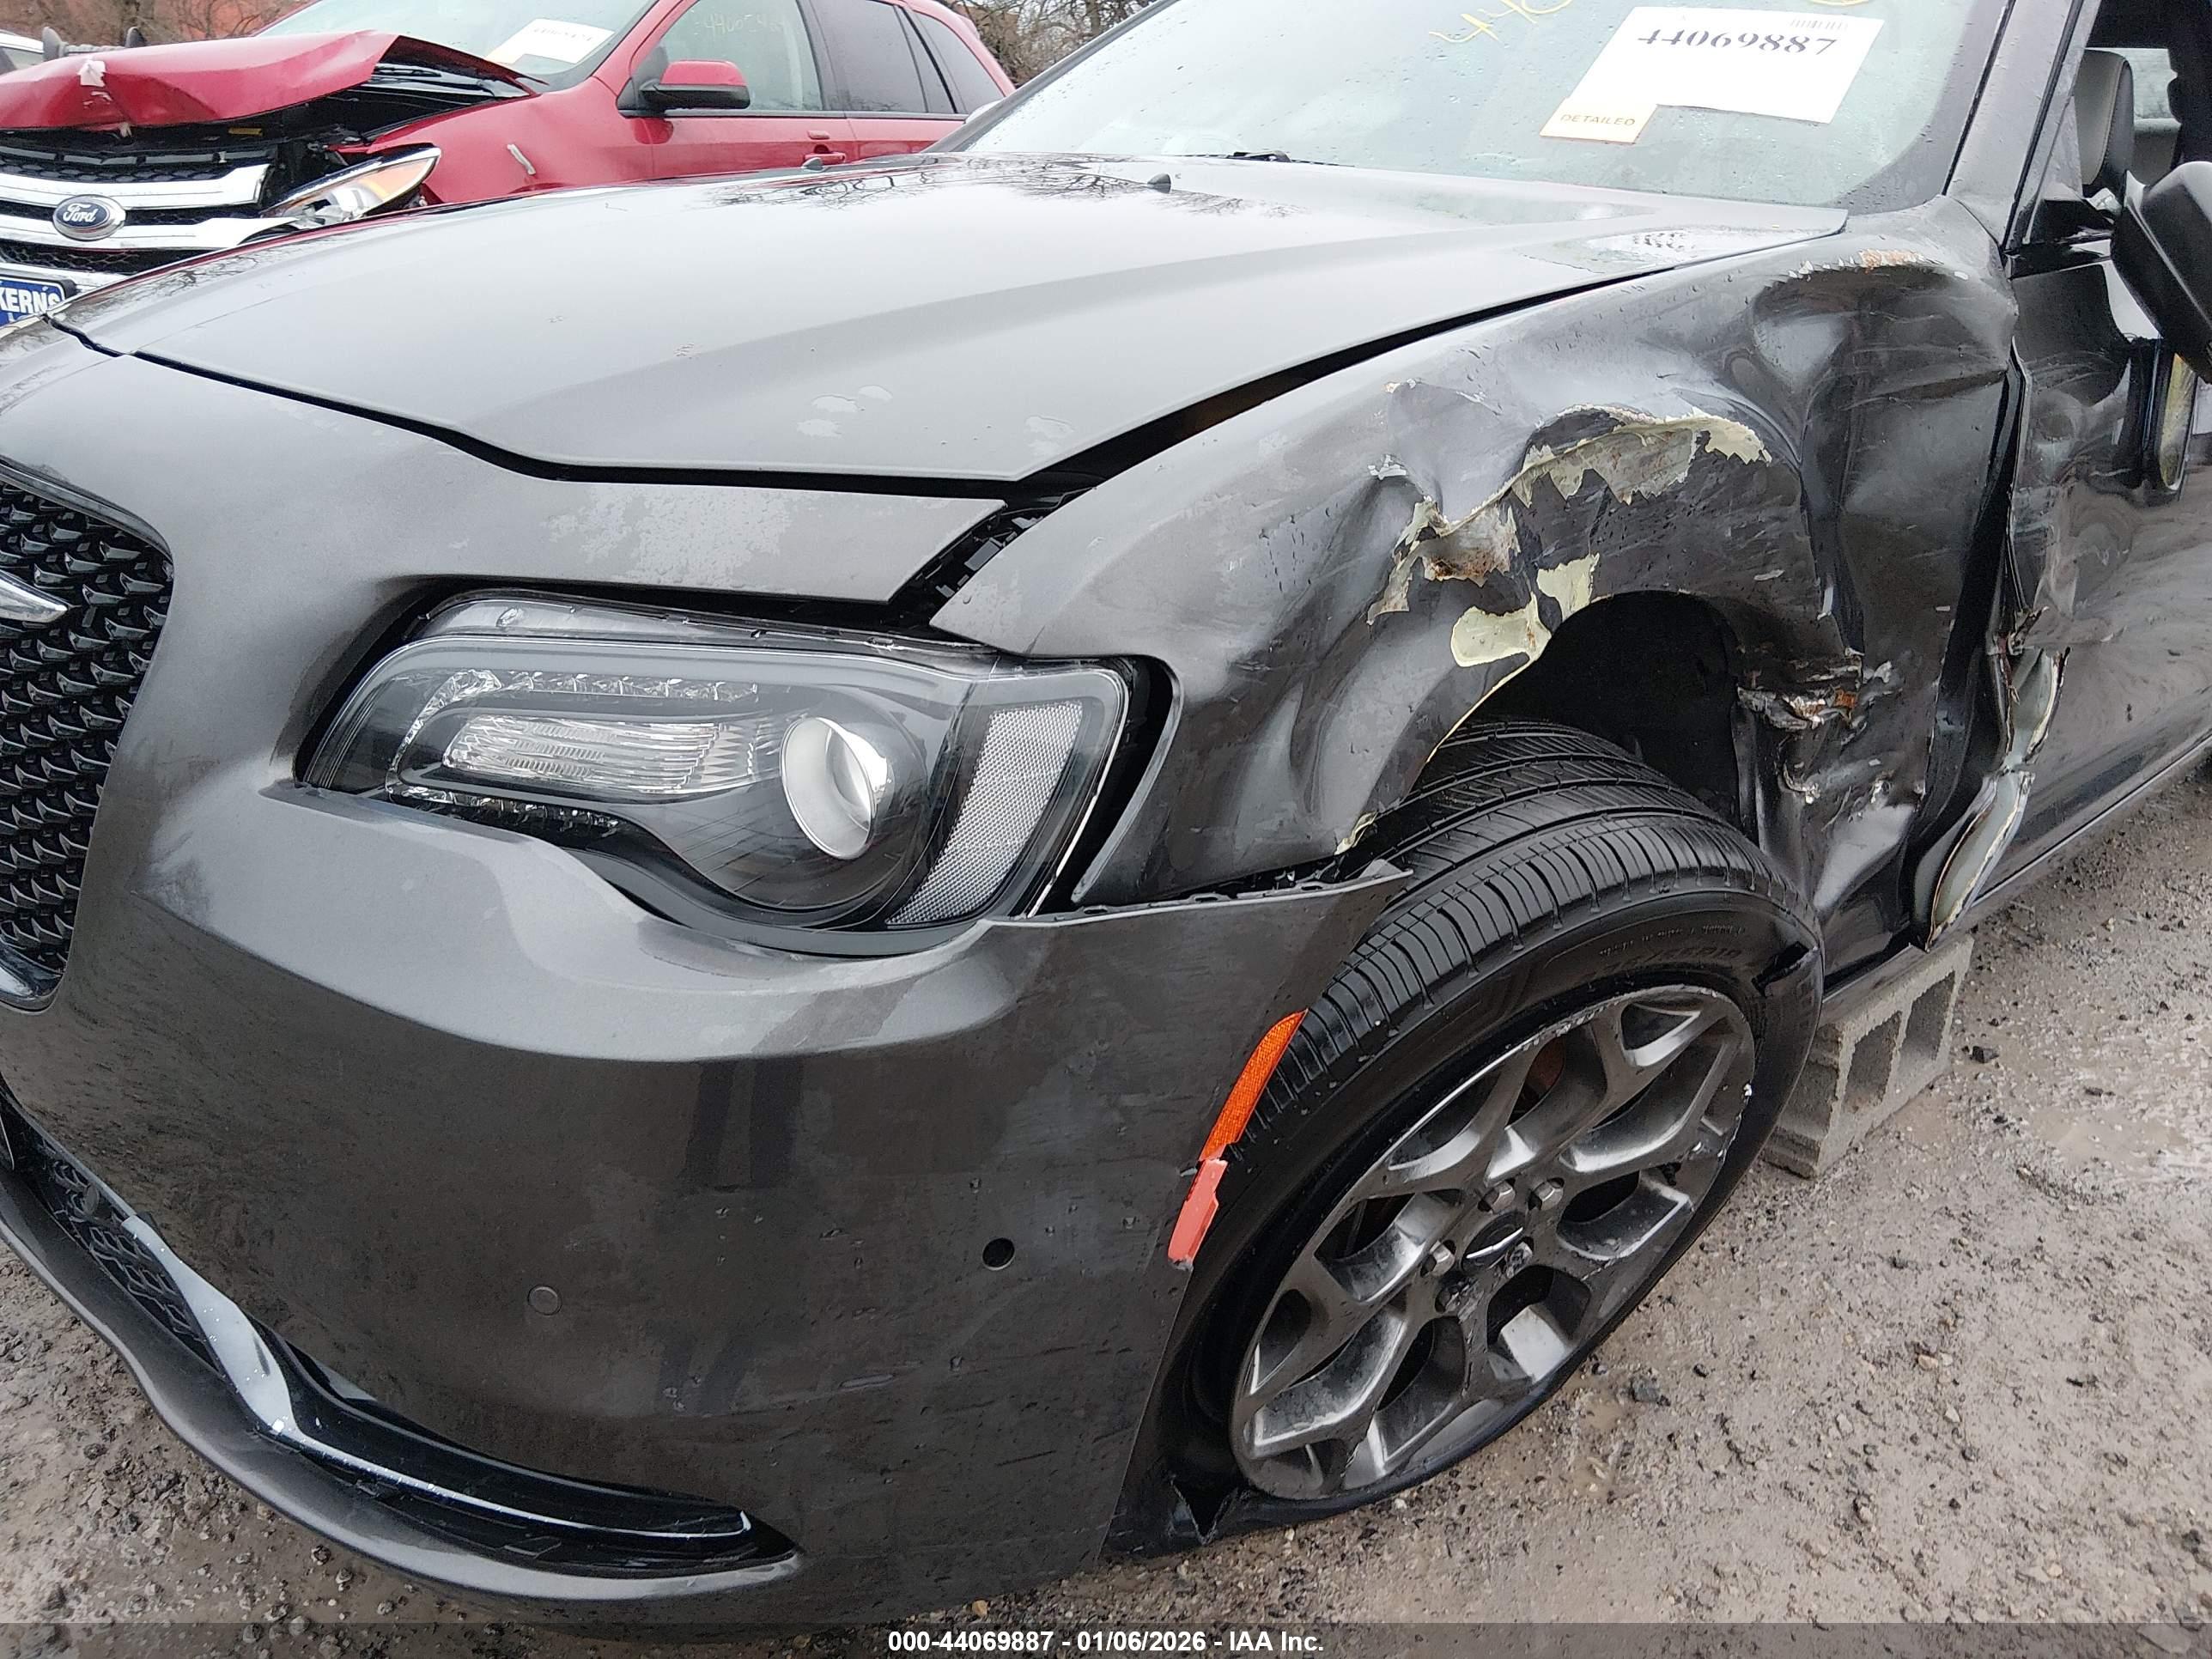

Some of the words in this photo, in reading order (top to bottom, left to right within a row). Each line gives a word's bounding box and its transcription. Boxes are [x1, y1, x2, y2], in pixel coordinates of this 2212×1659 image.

[1637, 28, 1838, 56] 44069887
[1559, 113, 1636, 127] DETAILED
[63, 203, 99, 222] Ford
